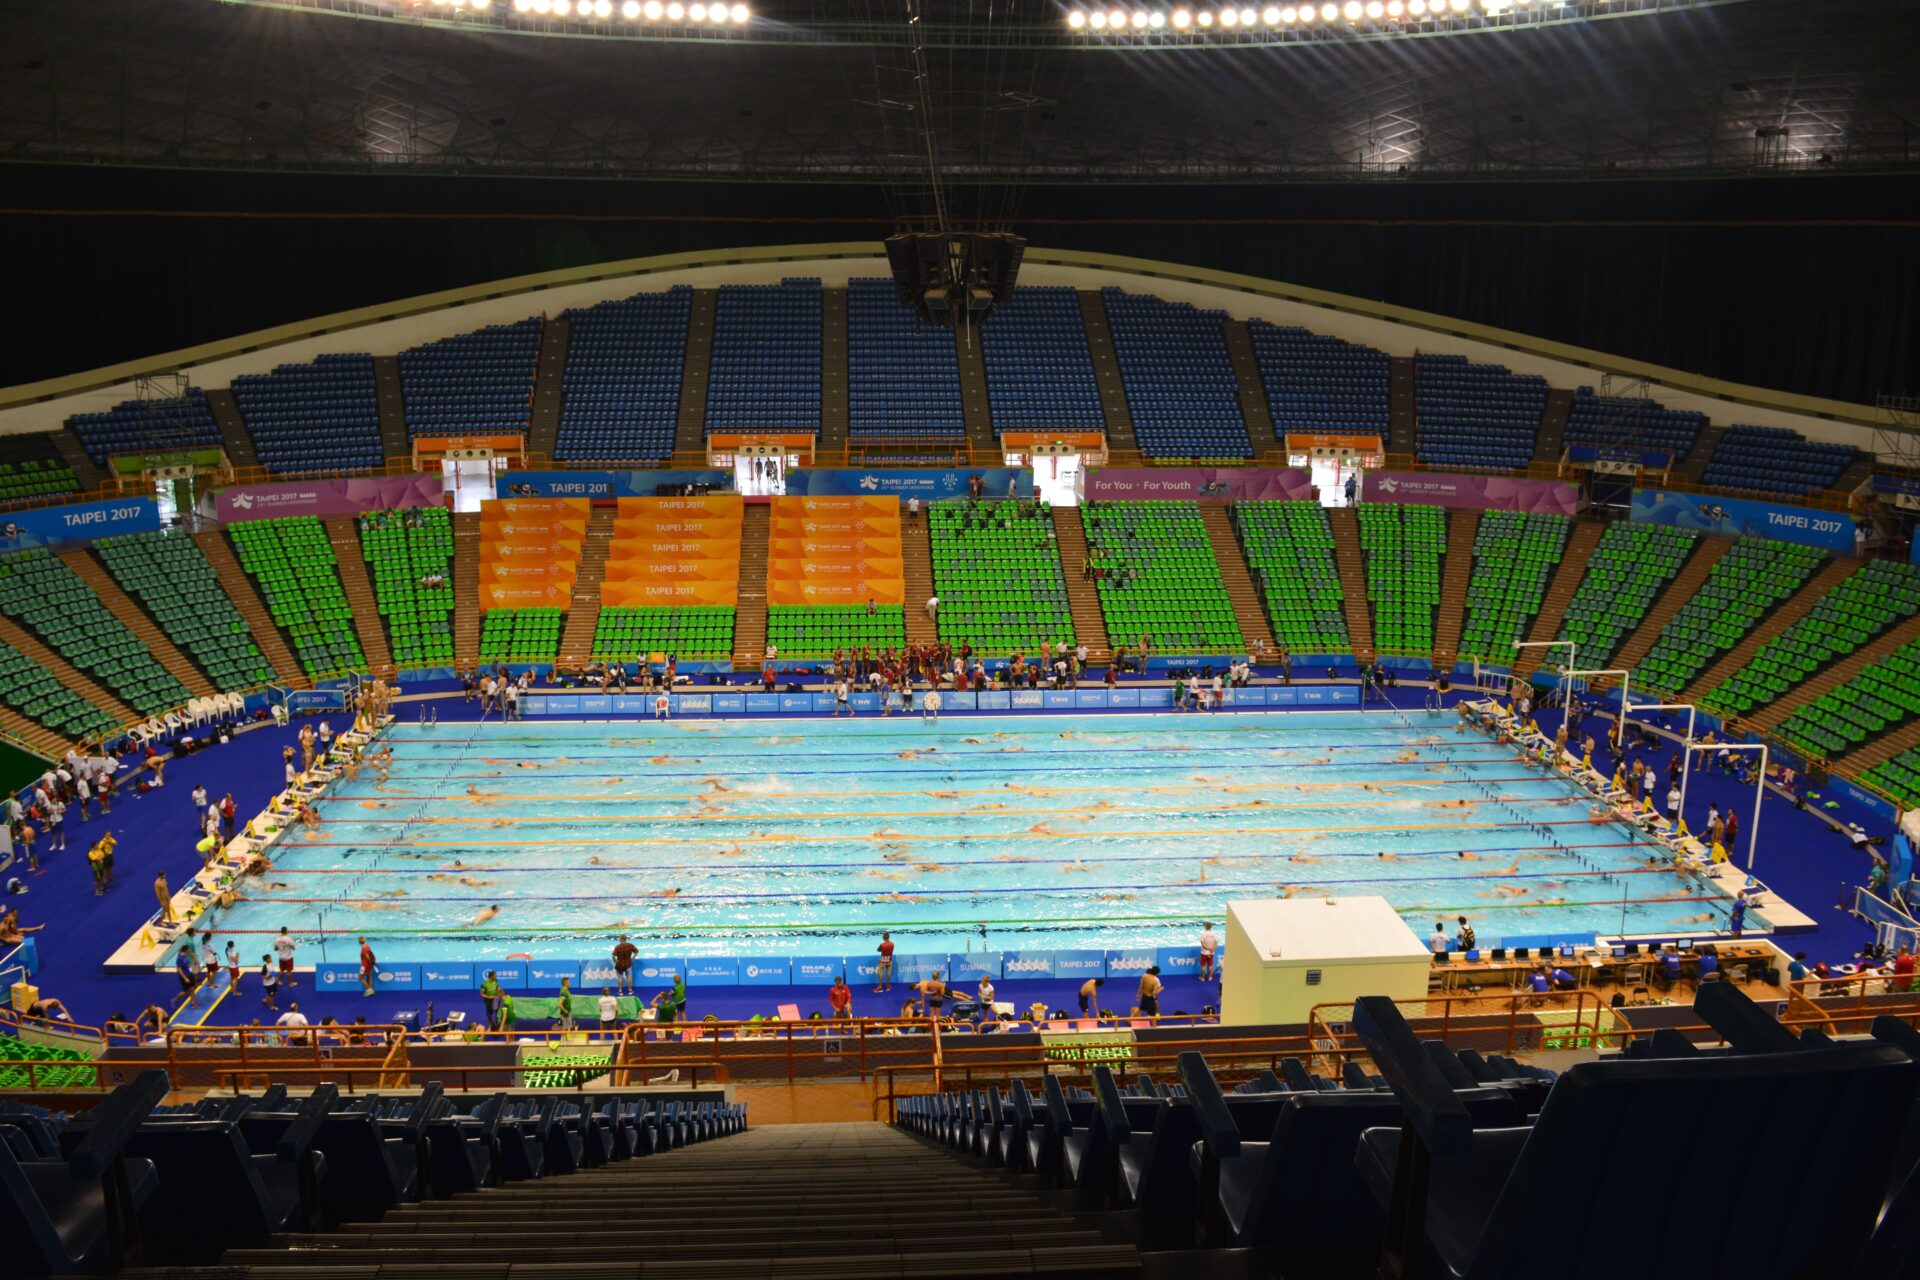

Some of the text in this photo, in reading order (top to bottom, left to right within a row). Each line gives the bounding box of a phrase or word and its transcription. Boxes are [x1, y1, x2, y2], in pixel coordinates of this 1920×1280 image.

[550, 483, 610, 493] TAIPEI 201
[1095, 480, 1191, 490] For You For Youth
[256, 494, 280, 503] TAIPEI
[64, 507, 141, 526] TAIPEI 2017
[1768, 512, 1842, 534] TAIPEI 2017
[899, 964, 946, 973] UNIVERSIADE
